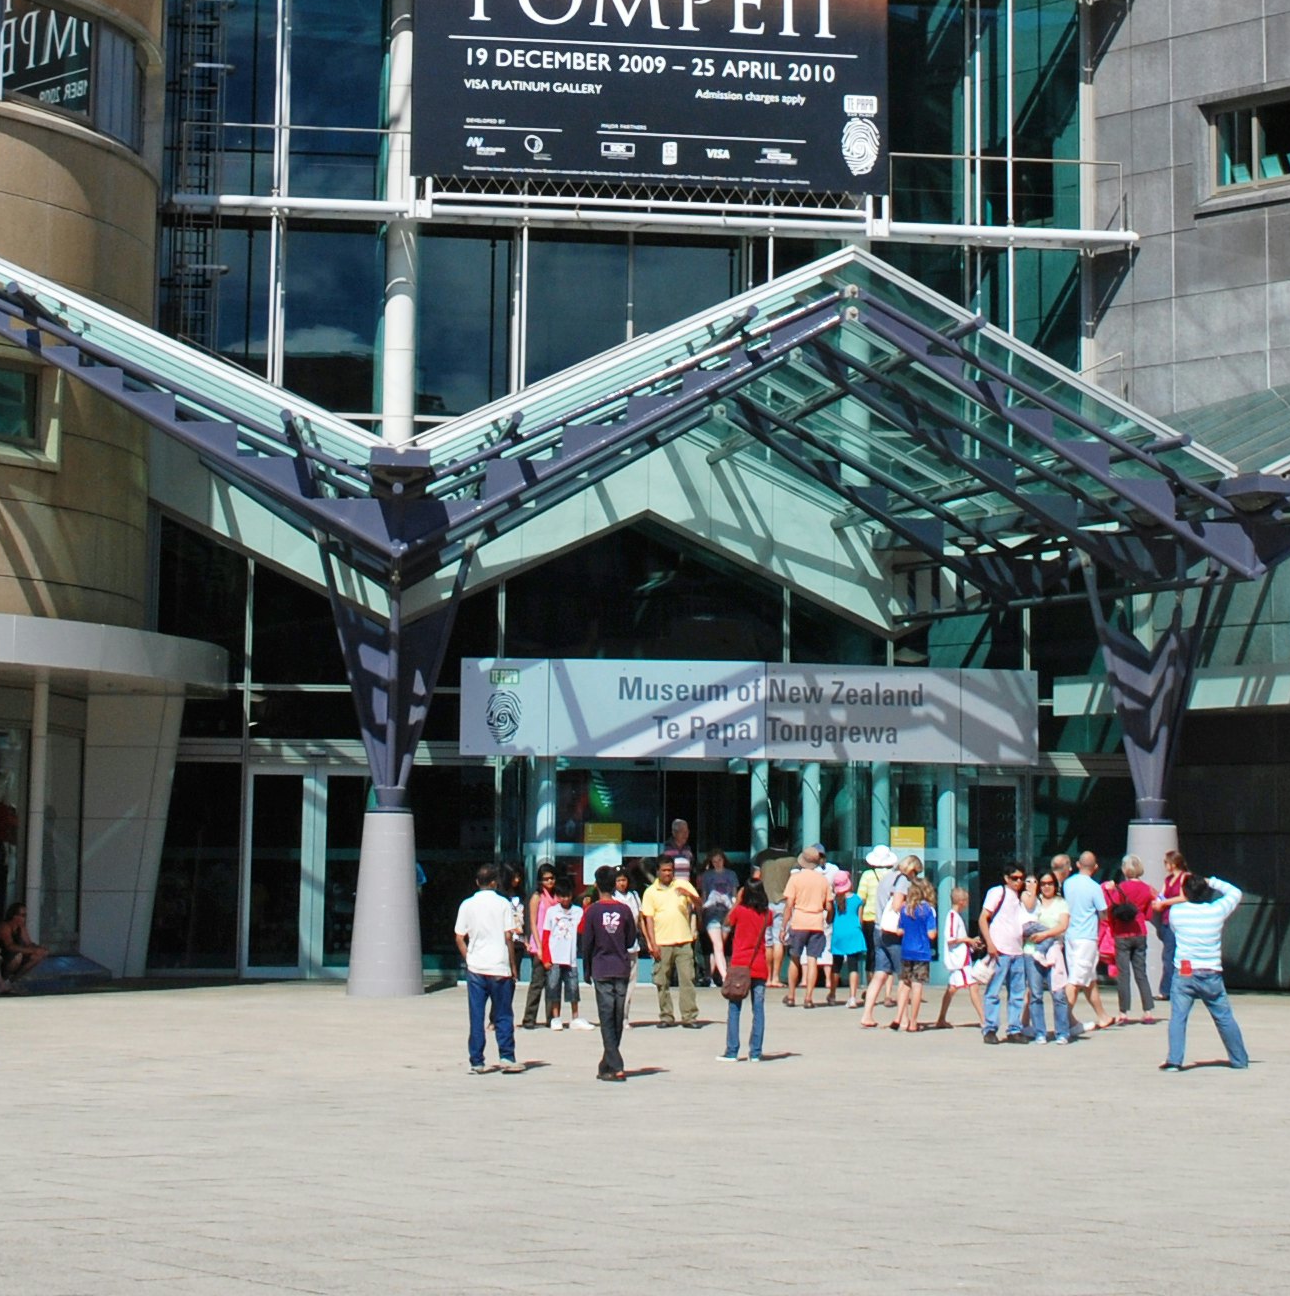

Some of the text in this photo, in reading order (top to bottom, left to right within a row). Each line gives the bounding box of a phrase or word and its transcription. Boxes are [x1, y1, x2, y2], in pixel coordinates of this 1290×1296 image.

[466, 47, 488, 66] 19
[495, 48, 612, 72] DECEMBER
[618, 53, 667, 74] 2009
[691, 58, 716, 77] 25
[721, 59, 782, 81] APRIL
[787, 63, 836, 83] 2010
[463, 78, 603, 95] VISA PLATINUM GALLERY
[694, 88, 807, 106] Admission charges apply
[705, 148, 731, 160] VISA
[617, 676, 924, 708] Museum of New Zealand
[652, 715, 898, 748] Te Papa Tongarewa
